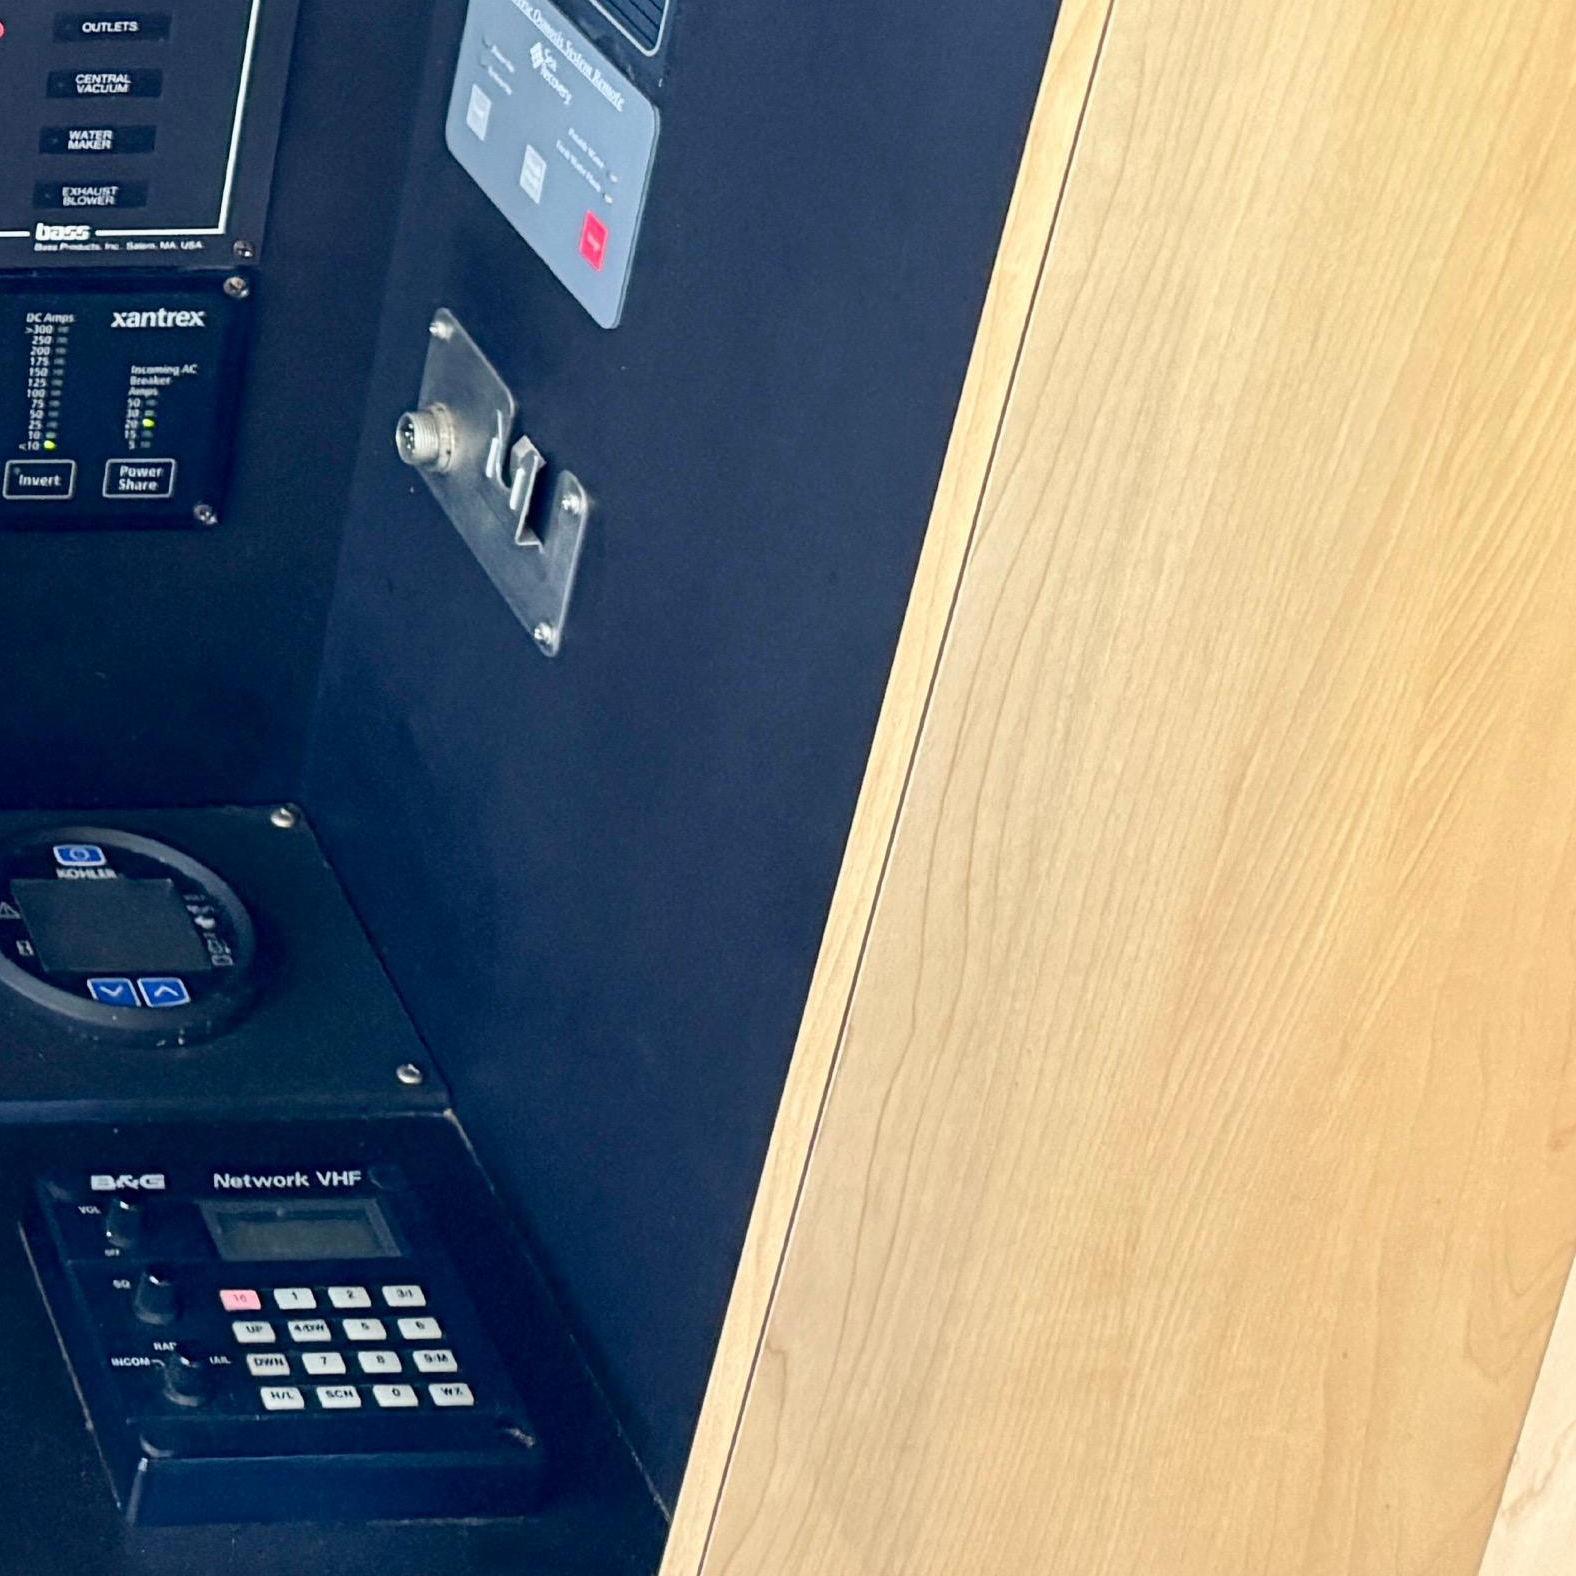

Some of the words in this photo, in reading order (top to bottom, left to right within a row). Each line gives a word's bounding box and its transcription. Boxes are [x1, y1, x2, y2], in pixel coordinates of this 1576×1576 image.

[76, 74, 131, 84] CENTRAL
[77, 84, 128, 93] VACUUM
[36, 224, 91, 240] bass
[111, 308, 204, 327] xantrex
[120, 466, 162, 477] Power
[19, 475, 59, 486] Invert
[119, 479, 157, 490] Share
[56, 869, 117, 879] KOHLER
[91, 1175, 165, 1190] B&G
[214, 1172, 309, 1188] Network
[316, 1171, 361, 1186] VHF
